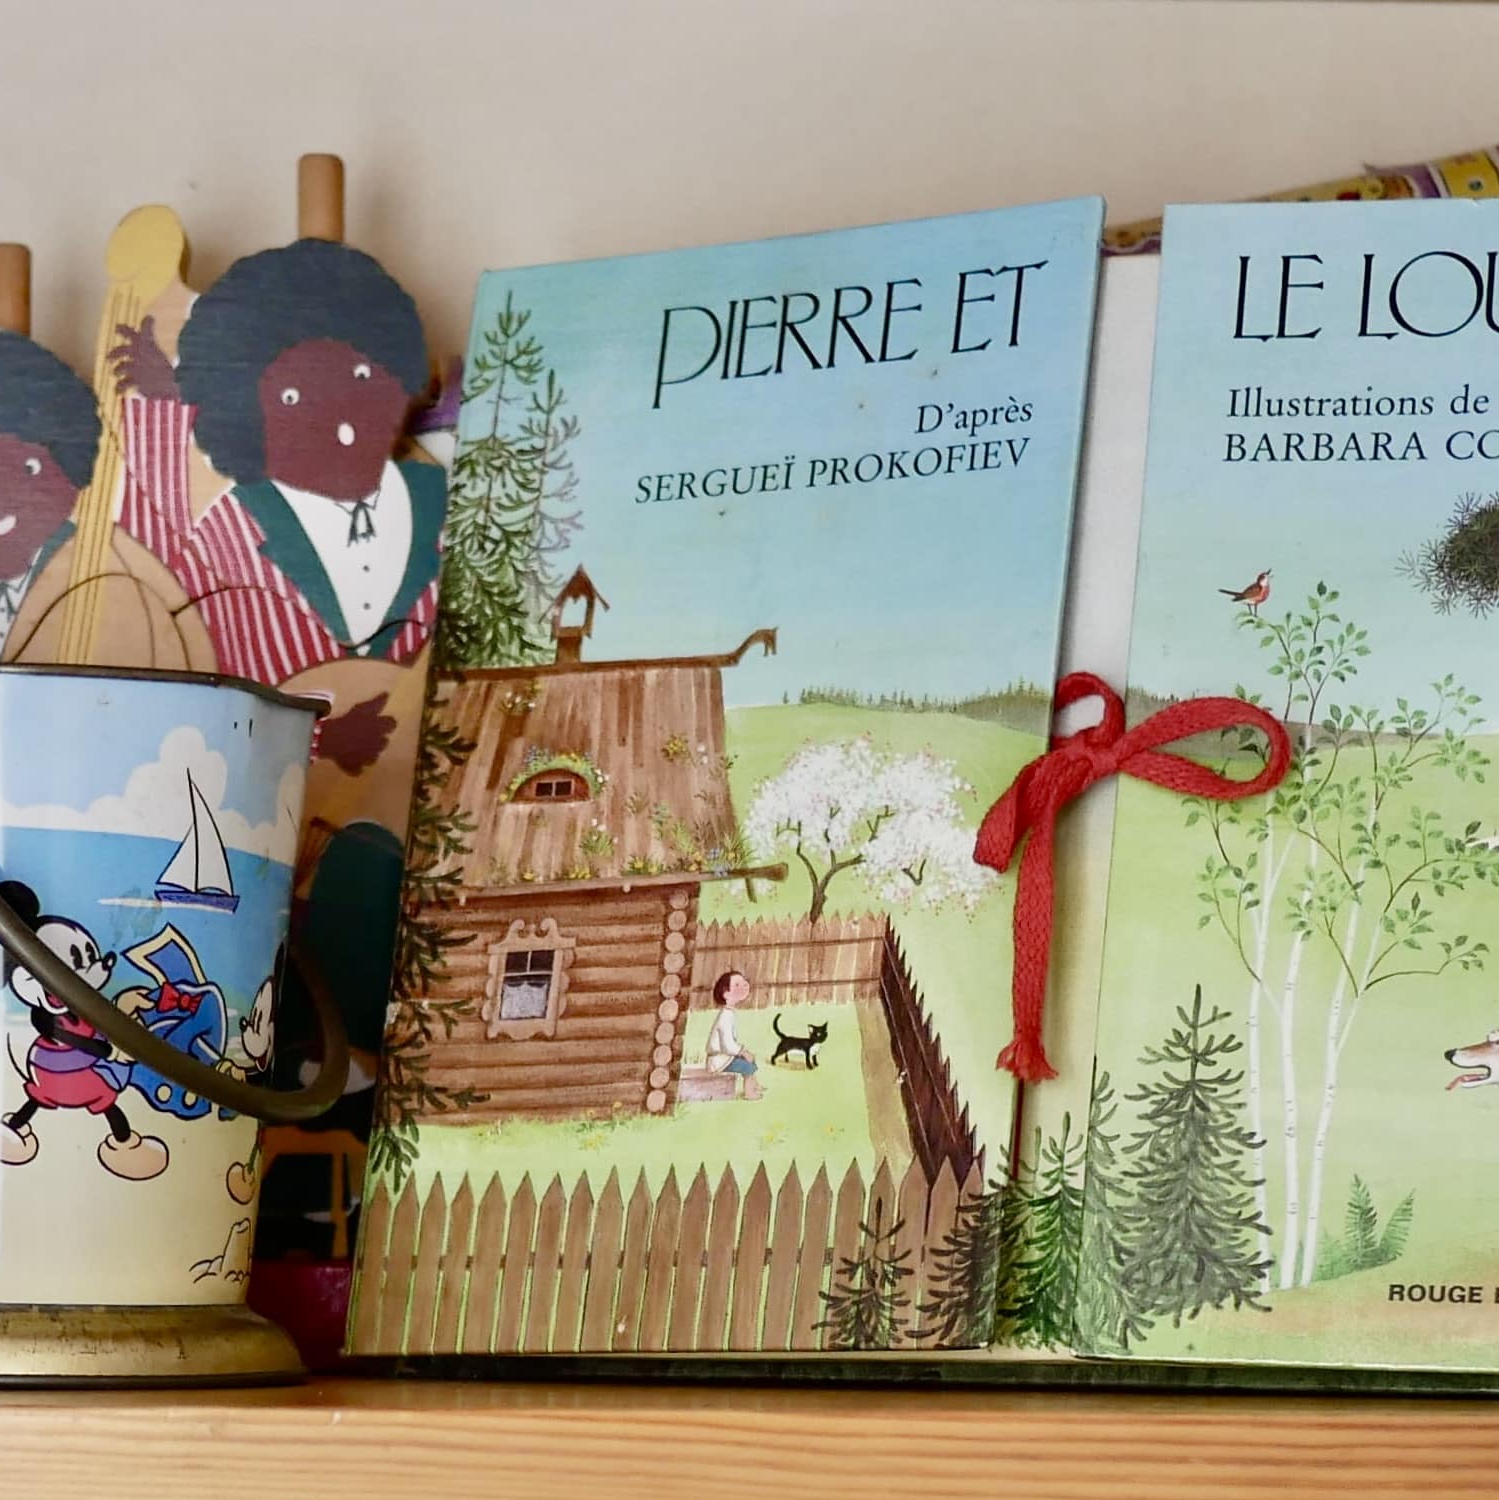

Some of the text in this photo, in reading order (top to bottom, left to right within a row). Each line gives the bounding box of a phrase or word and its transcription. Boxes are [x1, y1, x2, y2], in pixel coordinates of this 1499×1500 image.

[1233, 253, 1327, 343] LE
[654, 259, 1050, 409] PIERRE ET
[1228, 385, 1490, 420] Illustrations de
[635, 434, 1032, 506] SERGUEÏ PROKOFIEV
[1223, 428, 1427, 463] BARBARA
[1388, 1283, 1485, 1305] ROUGE
